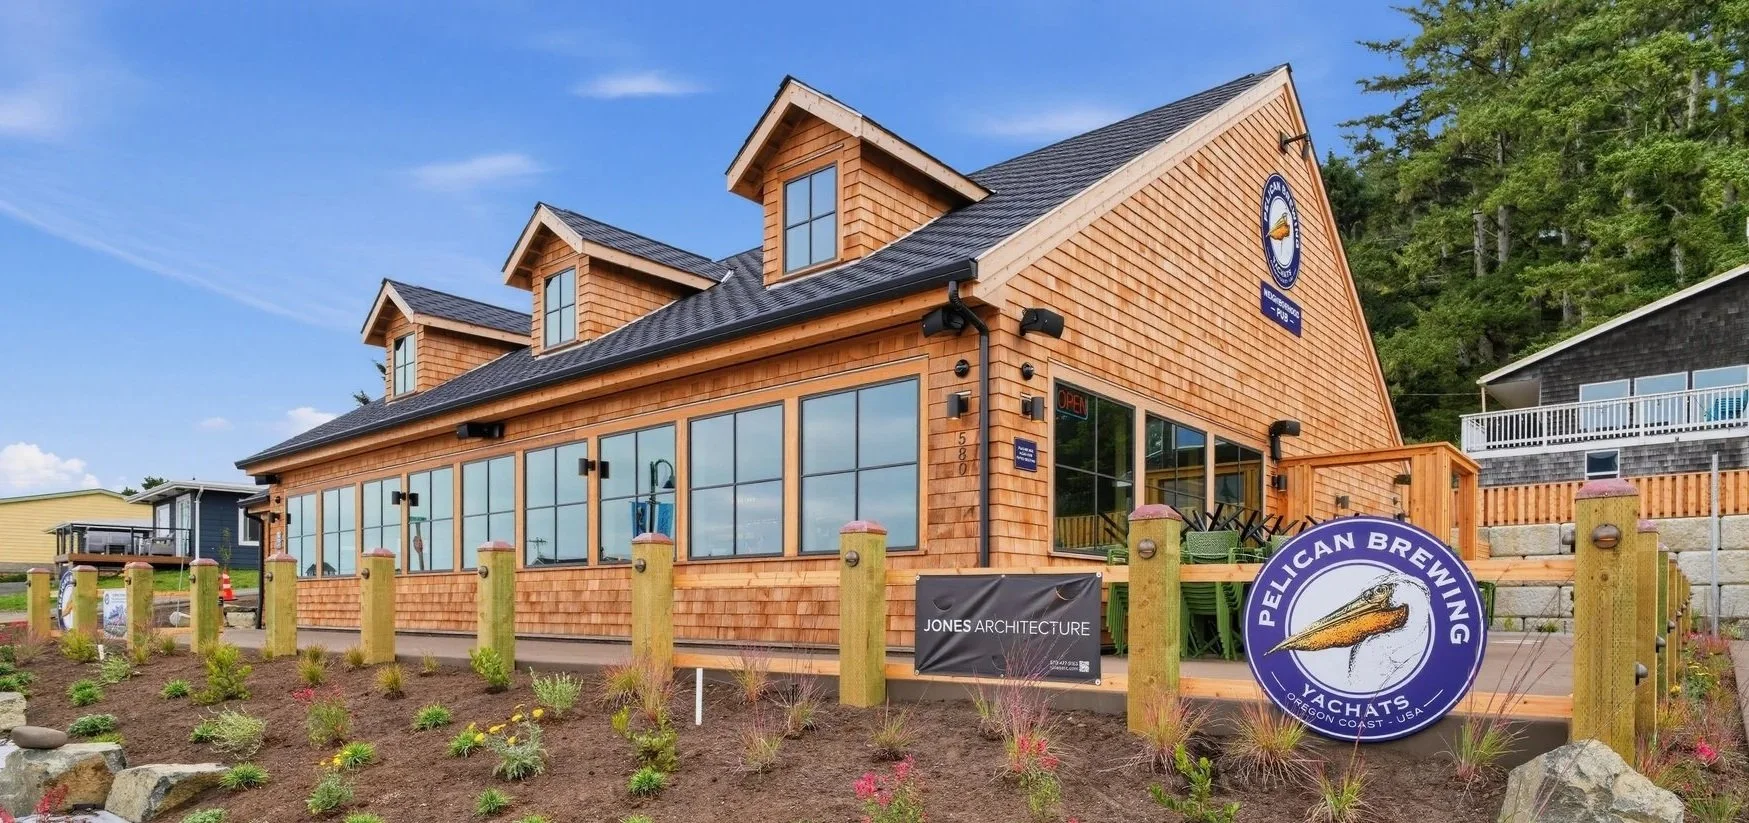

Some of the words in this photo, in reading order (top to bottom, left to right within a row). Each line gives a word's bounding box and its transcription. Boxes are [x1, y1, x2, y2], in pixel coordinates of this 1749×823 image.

[1264, 181, 1281, 222] PELICAN
[1281, 185, 1299, 249] BREWING
[1263, 288, 1300, 319] NEIGHBORHOOD
[1276, 307, 1289, 323] PUB
[1058, 389, 1087, 416] OPEN
[1258, 532, 1355, 627] PELICAN
[1367, 531, 1470, 645] BREWING
[923, 618, 972, 633] JONES
[974, 619, 1091, 636] ARCHITECTURE
[1287, 692, 1335, 723] OREGON
[1338, 719, 1384, 729] COAST
[1396, 707, 1424, 723] USA
[1301, 683, 1410, 718] YACHATS
